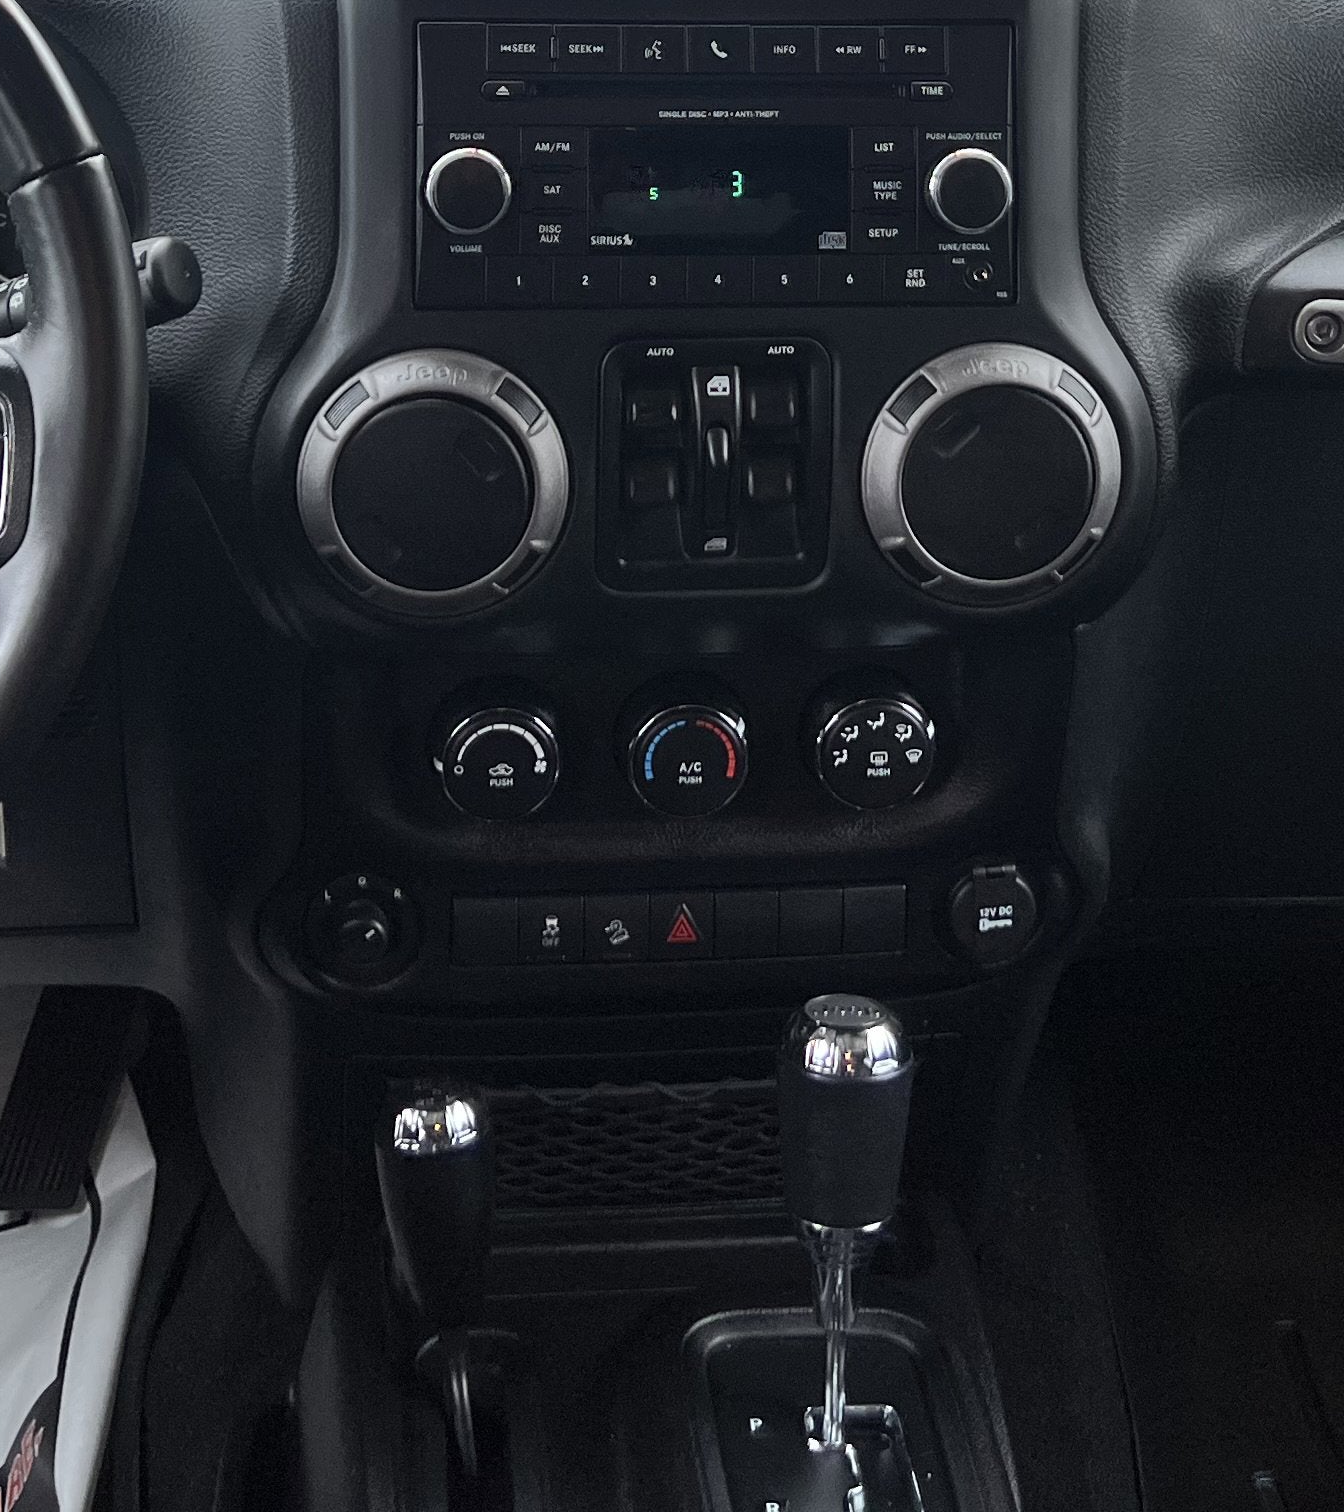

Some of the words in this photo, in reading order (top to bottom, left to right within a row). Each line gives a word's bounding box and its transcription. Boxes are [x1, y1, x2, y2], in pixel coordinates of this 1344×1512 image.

[773, 45, 796, 54] INFO
[846, 45, 862, 54] RW
[904, 45, 916, 54] FF
[921, 86, 944, 96] TIME
[449, 133, 471, 141] PUSH
[925, 132, 946, 141] PUSH
[534, 142, 570, 152] AM/FM
[874, 143, 894, 153] LIST
[732, 171, 744, 198] 3
[873, 181, 902, 190] MUSIC
[543, 185, 561, 195] SAT
[874, 191, 897, 201] TYPE
[538, 224, 562, 234] DISC
[868, 228, 899, 238] SETUP
[539, 234, 560, 244] AUX
[590, 235, 623, 246] SIRIUS
[449, 245, 483, 253] VOLUME
[906, 269, 924, 279] SET
[516, 275, 521, 286] 1
[582, 275, 589, 286] 2
[649, 276, 657, 286] 3
[714, 274, 722, 285] 4
[781, 275, 788, 285] 5
[846, 274, 854, 284] 6
[905, 278, 926, 288] RND
[646, 347, 675, 357] AUTO
[767, 345, 795, 355] AUTO
[679, 761, 702, 774] A/C
[866, 767, 891, 777] PUSH
[489, 777, 514, 787] PUSH
[678, 775, 703, 785] PUSH
[749, 1417, 763, 1432] P
